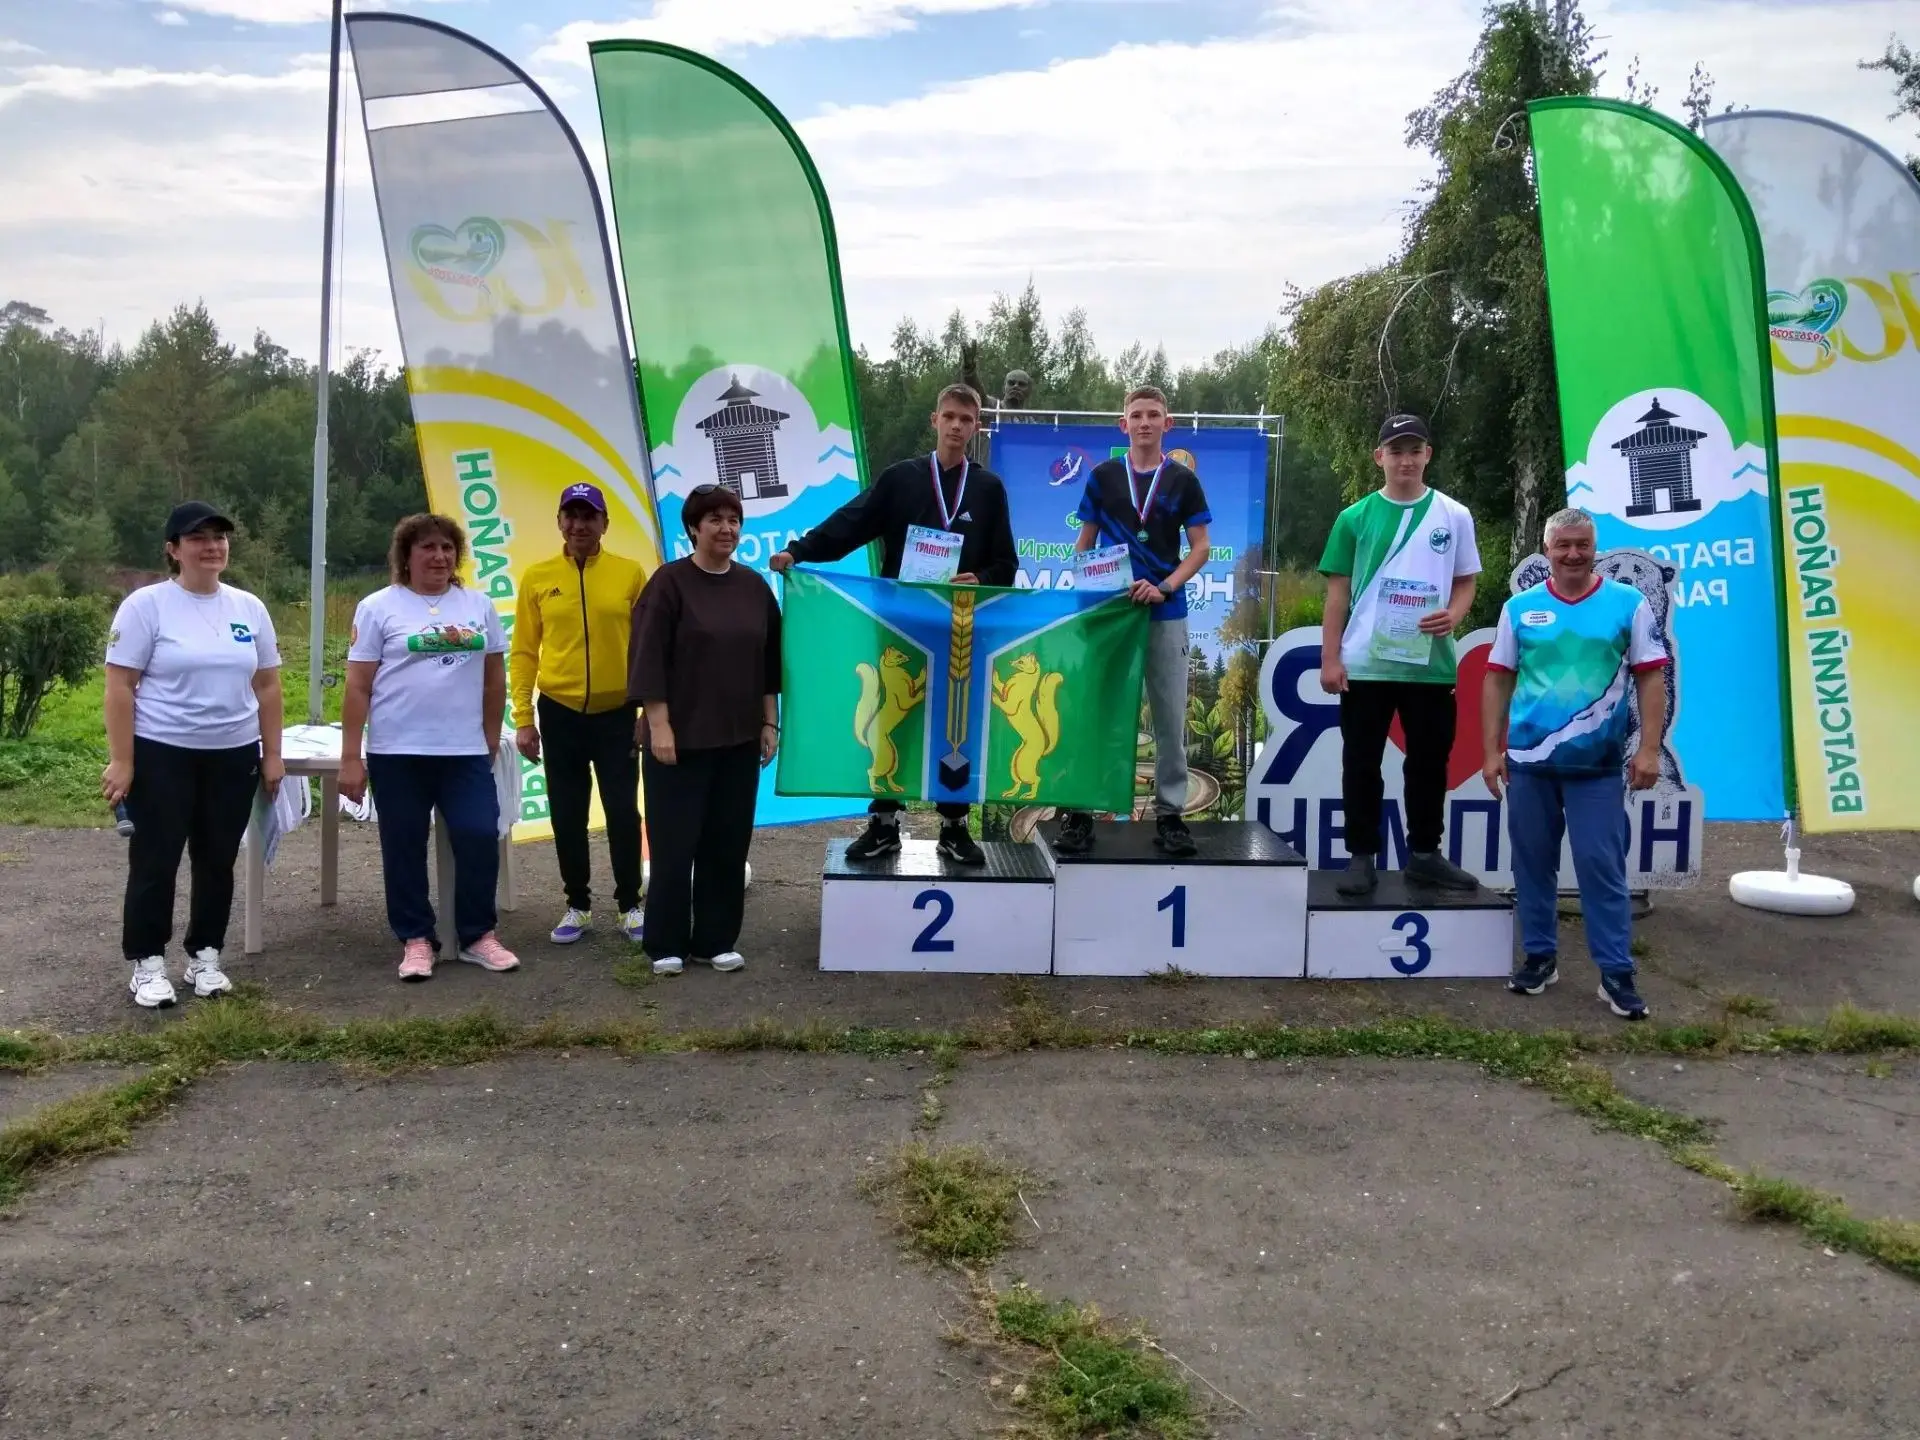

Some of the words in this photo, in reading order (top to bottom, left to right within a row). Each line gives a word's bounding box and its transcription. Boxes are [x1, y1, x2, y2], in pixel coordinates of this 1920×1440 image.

[911, 889, 955, 953] 2
[1157, 885, 1187, 948] 1
[1389, 911, 1432, 975] 3
